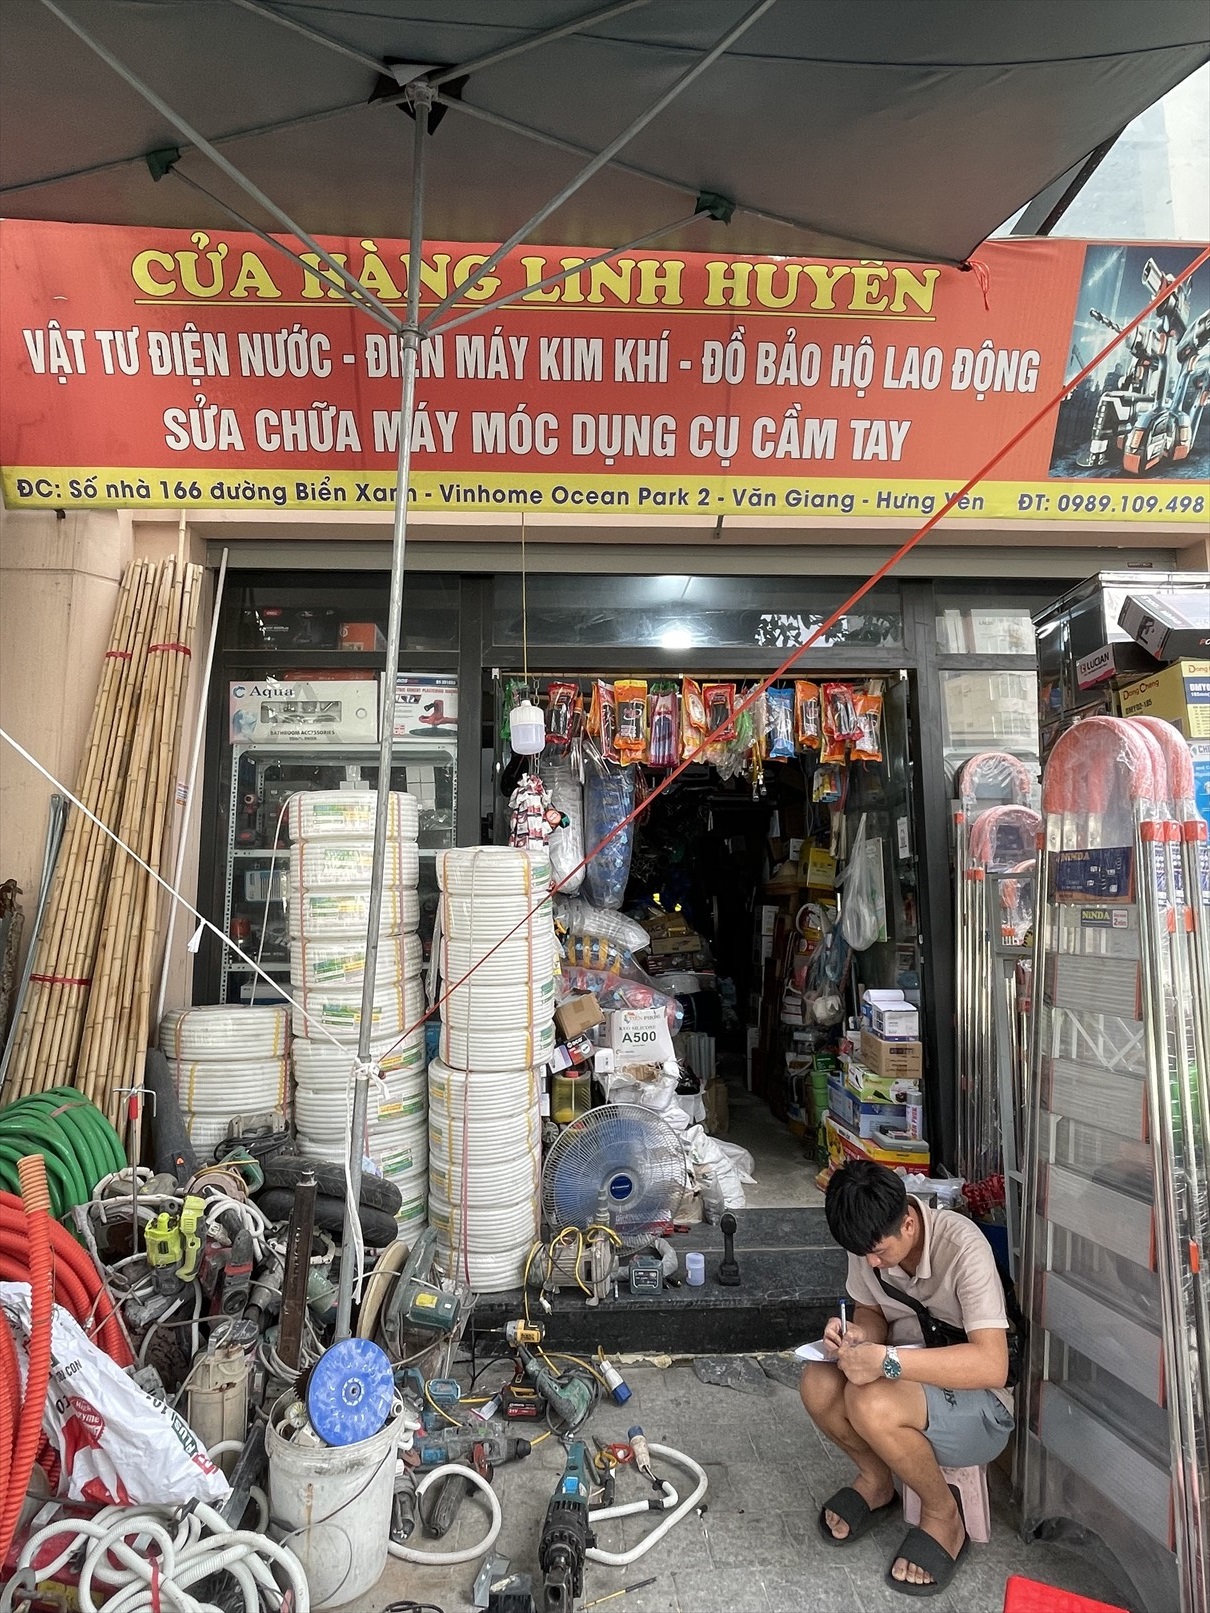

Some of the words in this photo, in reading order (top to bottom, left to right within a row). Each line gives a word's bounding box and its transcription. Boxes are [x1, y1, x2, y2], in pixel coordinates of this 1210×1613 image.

[131, 232, 282, 300] CỬA
[299, 239, 502, 300] HÀNG
[520, 256, 685, 304] LINH
[22, 319, 86, 384] VẬT
[94, 326, 139, 376] TƯ
[147, 322, 230, 386] ĐIỆN
[238, 323, 332, 378] NƯỚC
[365, 332, 445, 378] ĐIN
[455, 326, 529, 380] MÁY
[540, 337, 603, 382] KIM
[614, 330, 670, 383] KHÍ
[701, 325, 746, 385] ĐỒ
[755, 327, 822, 387] BẢO
[830, 335, 875, 398] HỘ
[883, 346, 944, 391] LAO
[950, 339, 1041, 401] ĐỘNG
[163, 393, 245, 451] SỬA
[255, 401, 362, 452] CHỮA
[372, 401, 459, 453] MÁY
[472, 403, 559, 455] MÓC
[572, 411, 676, 465] DỤNG
[689, 415, 740, 467] CỤ
[751, 403, 838, 460] CẦM
[850, 419, 912, 461] TAY
[17, 478, 61, 498] ĐC:
[69, 475, 98, 499] Số
[106, 479, 151, 499] nhà
[160, 480, 202, 500] 166
[210, 479, 287, 505] đường
[295, 475, 347, 502] Biển
[439, 484, 543, 505] Vinhome
[551, 485, 629, 506] Ocean
[638, 487, 690, 506] Park
[698, 487, 710, 506] 2
[732, 487, 776, 507] Văn
[785, 489, 855, 514] Giang
[876, 491, 935, 515] Hưng
[944, 492, 984, 510] Yên
[1018, 493, 1050, 512] ĐT:
[1057, 494, 1204, 513] 0989.109.498
[249, 685, 293, 698] Aqua
[1081, 910, 1110, 920] NINDA
[621, 1030, 657, 1043] A500
